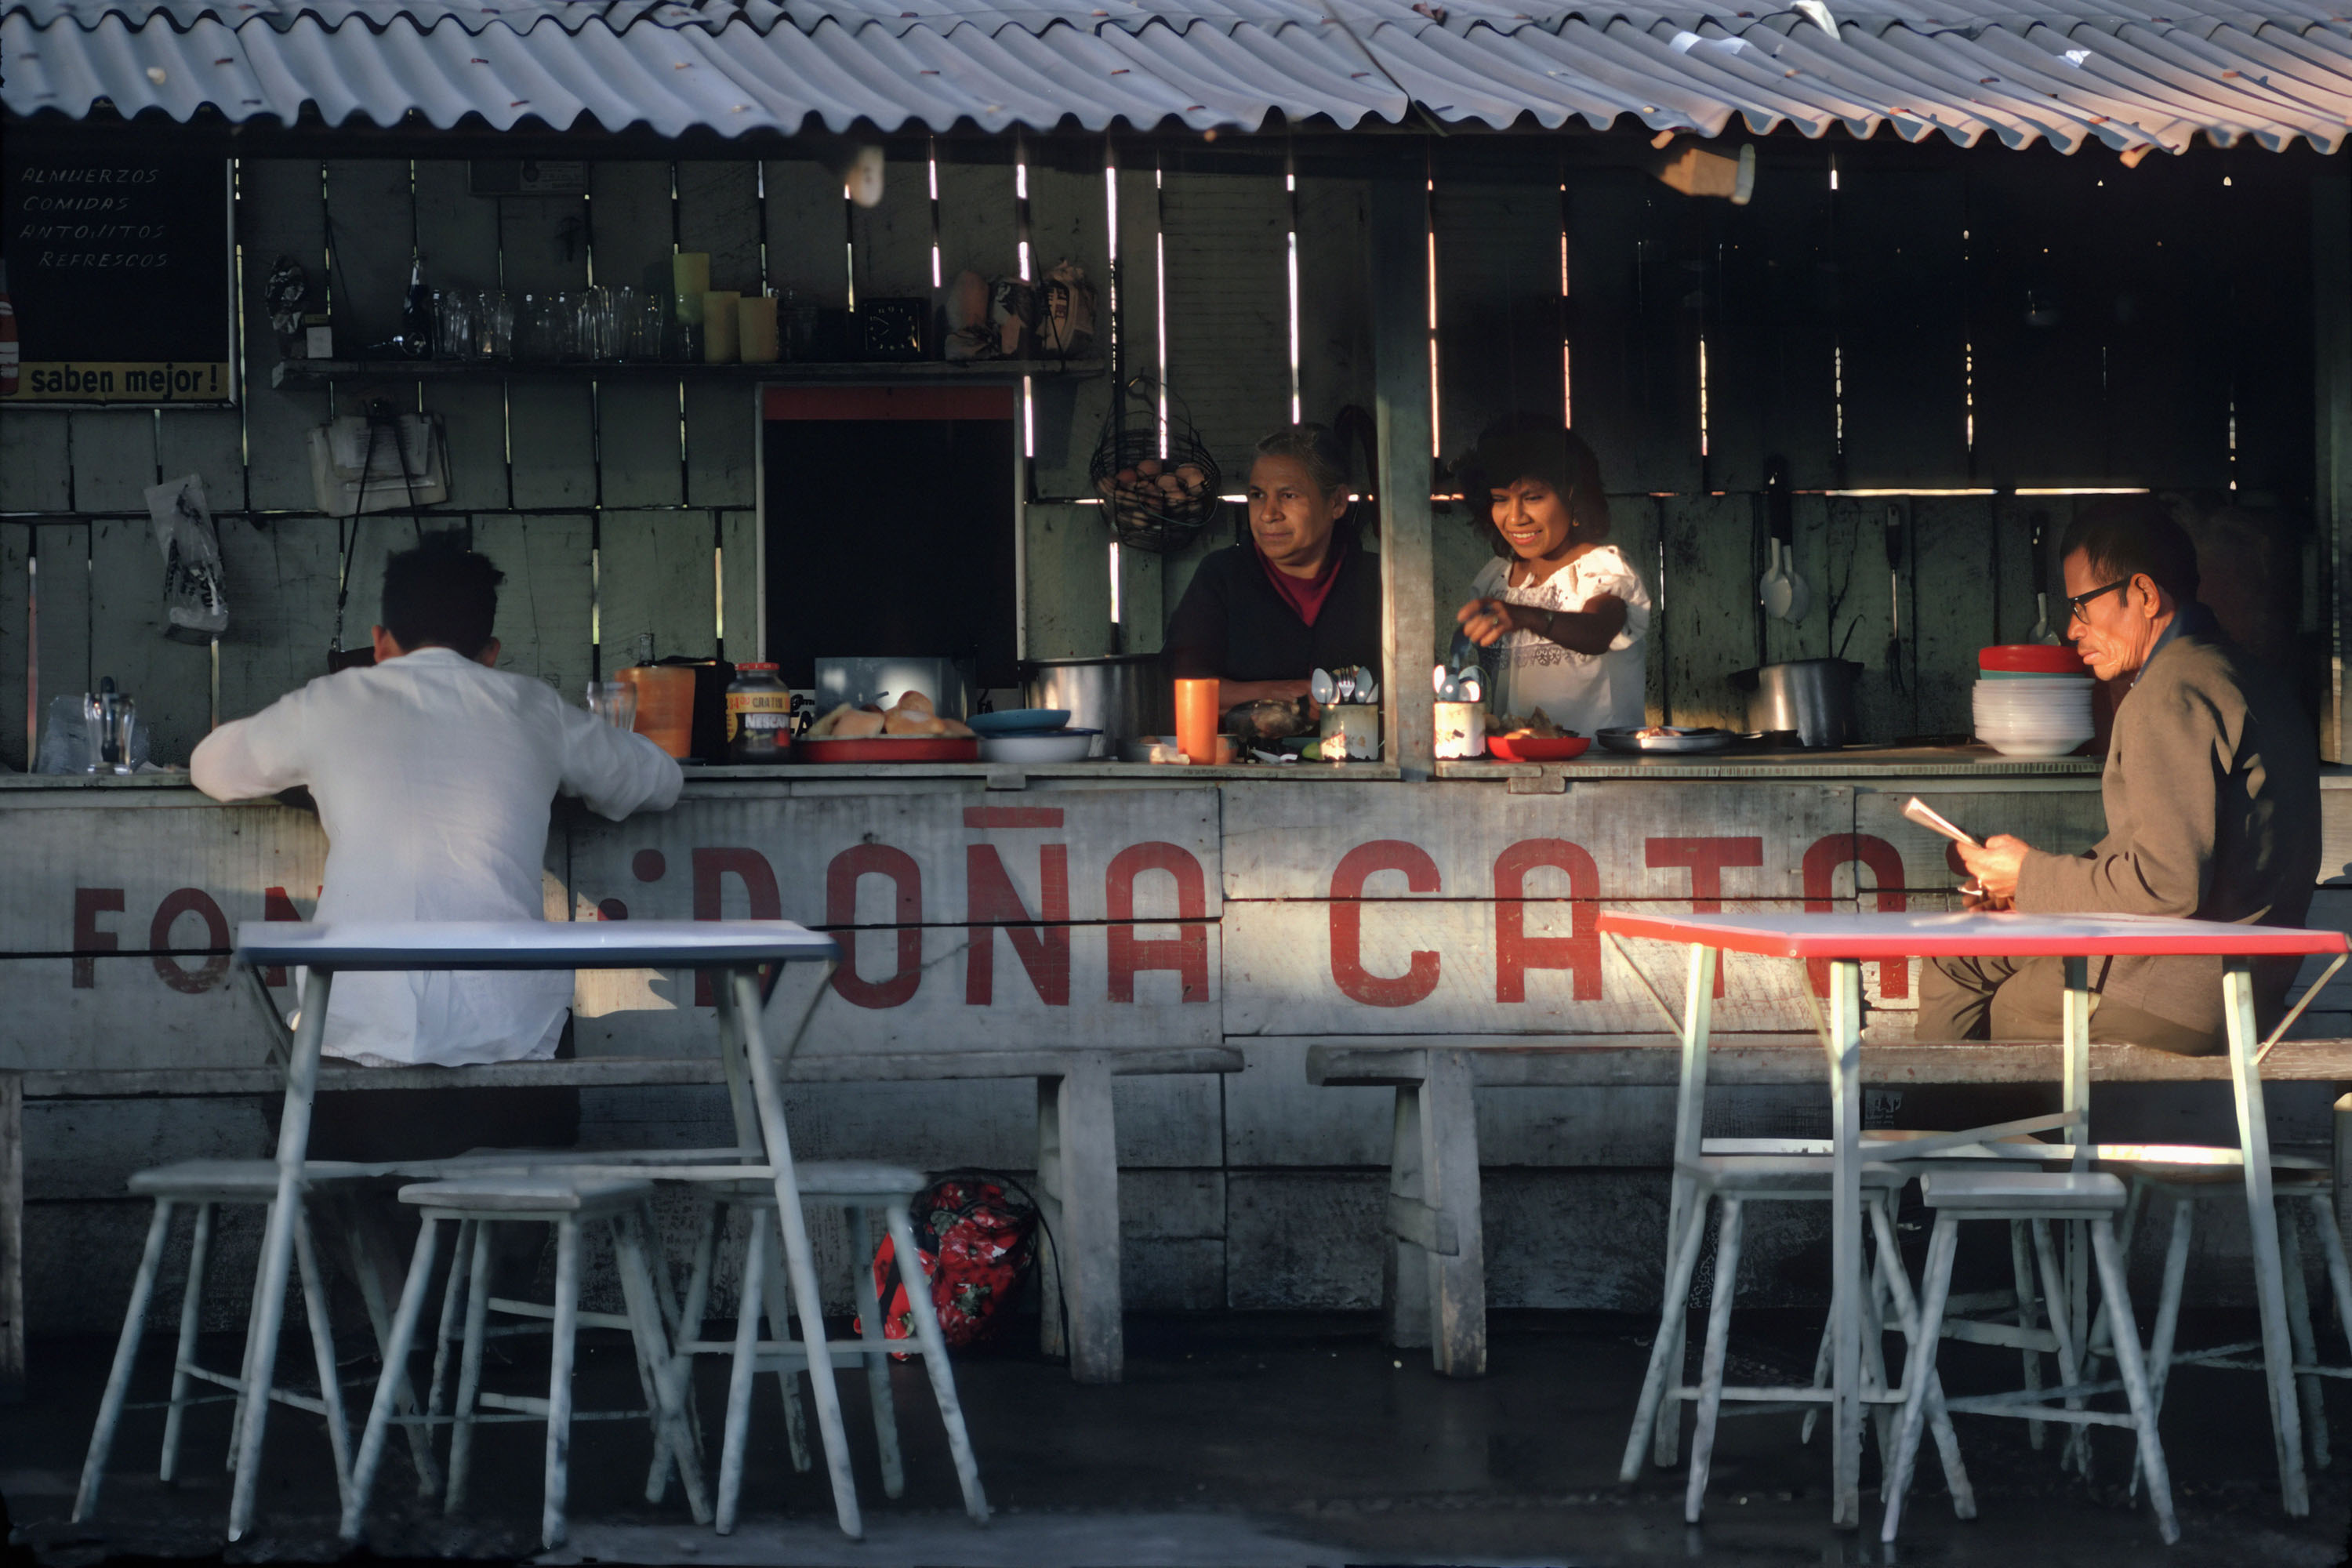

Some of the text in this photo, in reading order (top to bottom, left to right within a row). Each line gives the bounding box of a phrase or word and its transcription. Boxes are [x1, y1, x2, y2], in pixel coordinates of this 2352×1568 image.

[21, 167, 159, 183] ALMUERZOS
[23, 196, 130, 212] COMIDAS
[19, 224, 166, 239] ANTOJITOS
[38, 251, 169, 267] REFRESCOS
[31, 363, 114, 393] saben
[691, 807, 1210, 1010] DOÑA
[1330, 833, 1909, 1008] CATA
